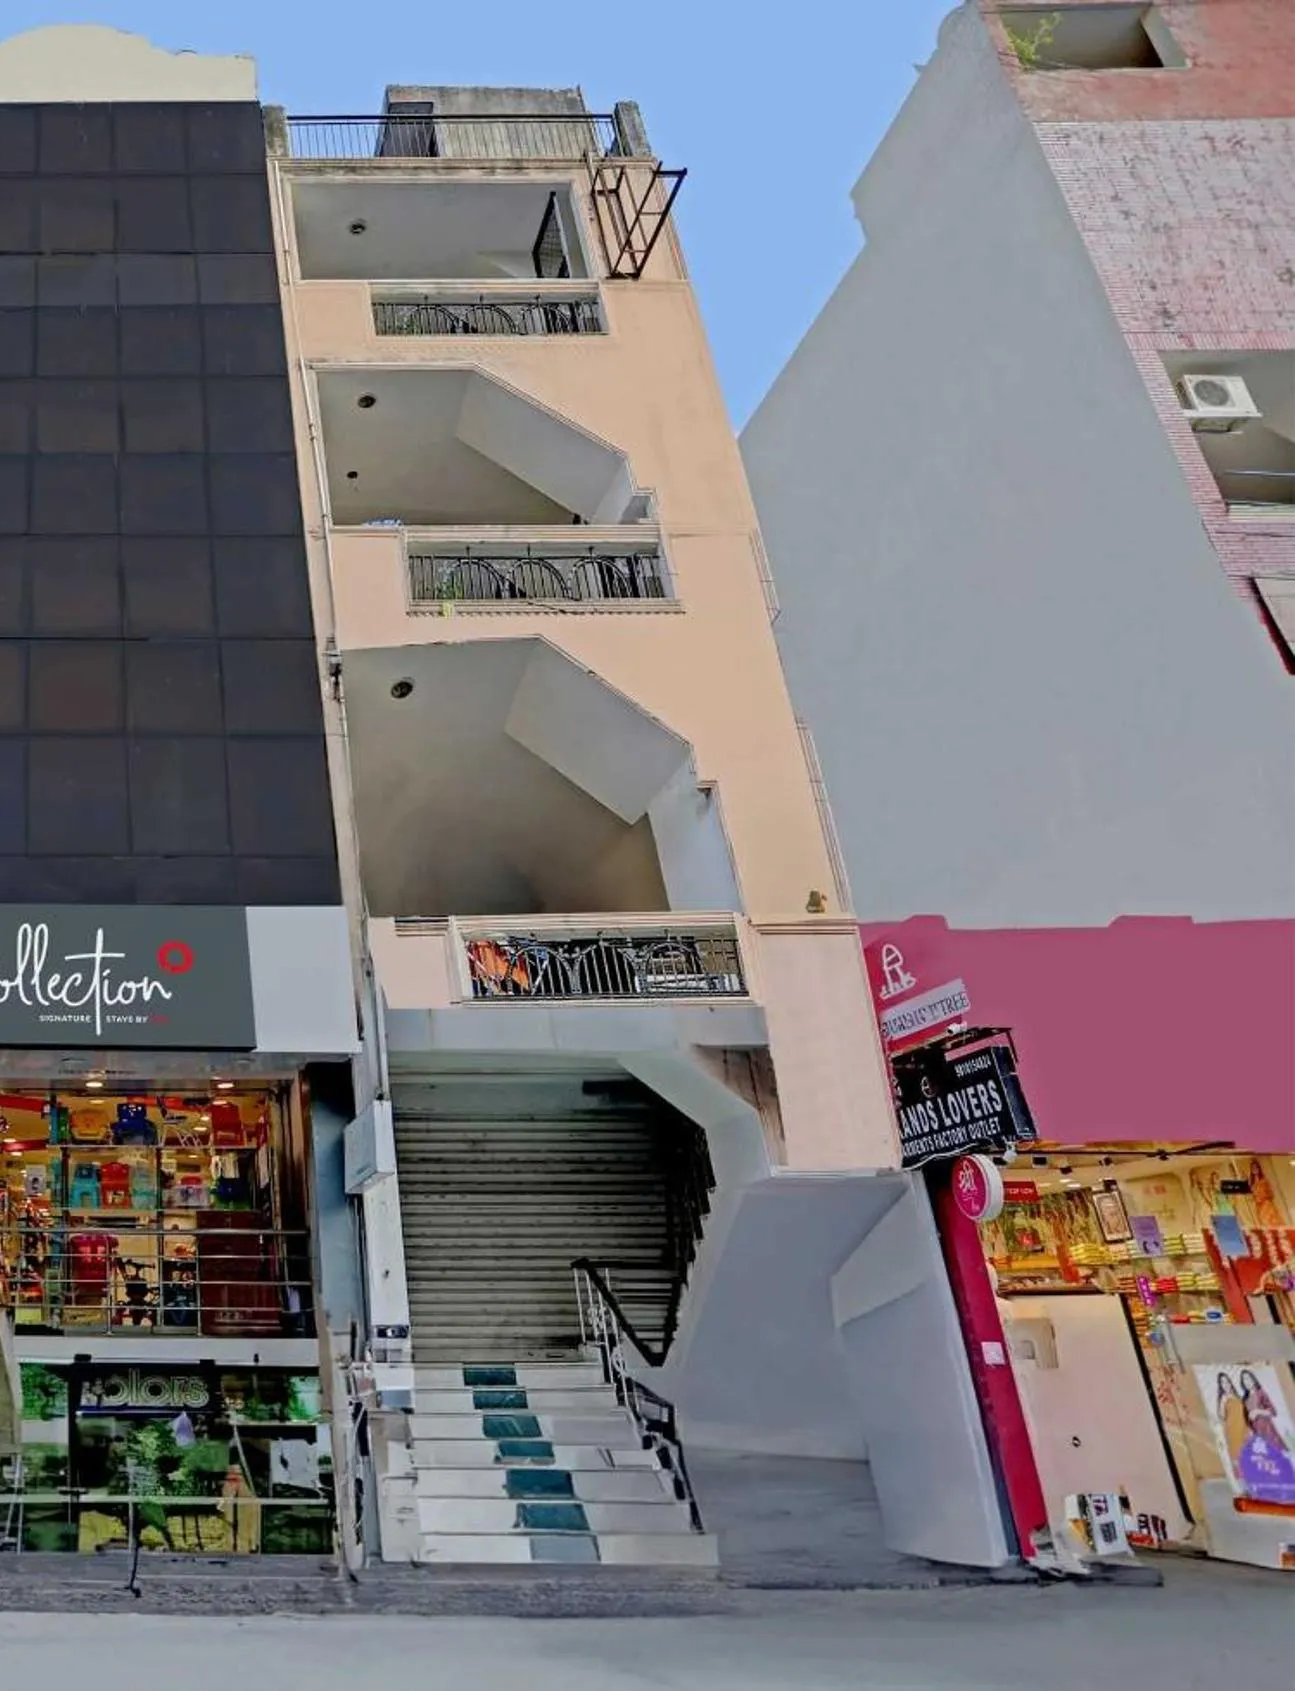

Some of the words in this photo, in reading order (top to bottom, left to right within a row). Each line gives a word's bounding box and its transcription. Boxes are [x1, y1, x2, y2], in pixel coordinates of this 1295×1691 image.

[38, 1014, 92, 1024] SIGNATURE
[105, 1014, 133, 1024] STAYS
[135, 1014, 149, 1024] BY
[937, 1079, 1003, 1127] LOVERS
[932, 1125, 969, 1150] FACTORY
[967, 1116, 1001, 1140] OUTLET
[80, 1367, 210, 1409] olors
